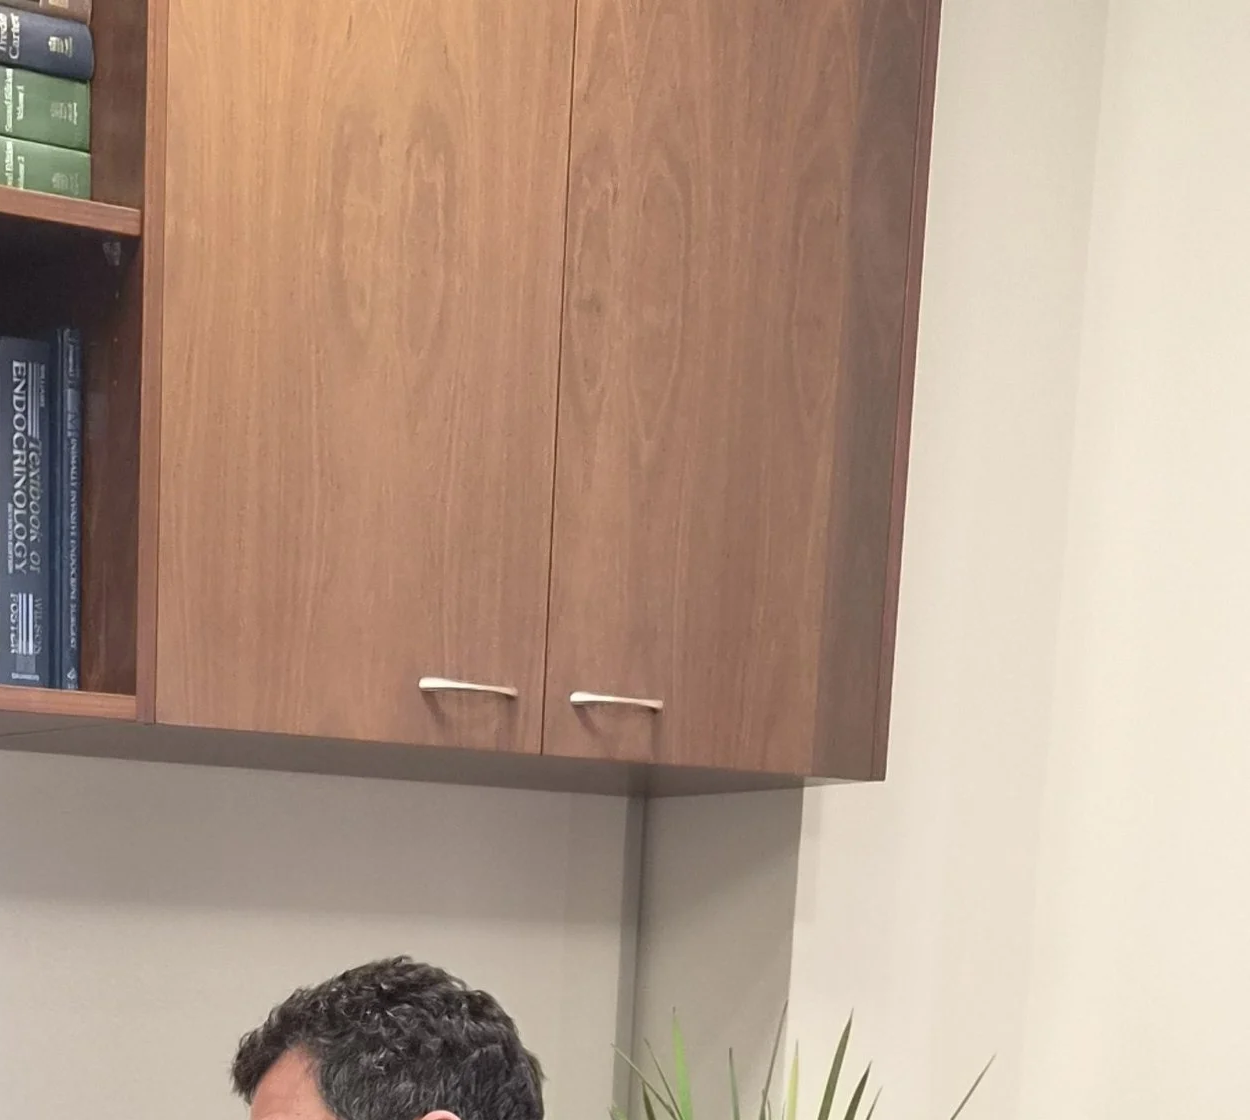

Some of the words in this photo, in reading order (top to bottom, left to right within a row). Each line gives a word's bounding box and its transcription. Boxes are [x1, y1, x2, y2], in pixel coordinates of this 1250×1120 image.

[12, 360, 28, 575] ENDOCRINOLOGY
[28, 441, 43, 543] Textbook
[29, 551, 41, 574] of
[10, 593, 19, 654] FOSTER
[33, 597, 43, 655] WILSON
